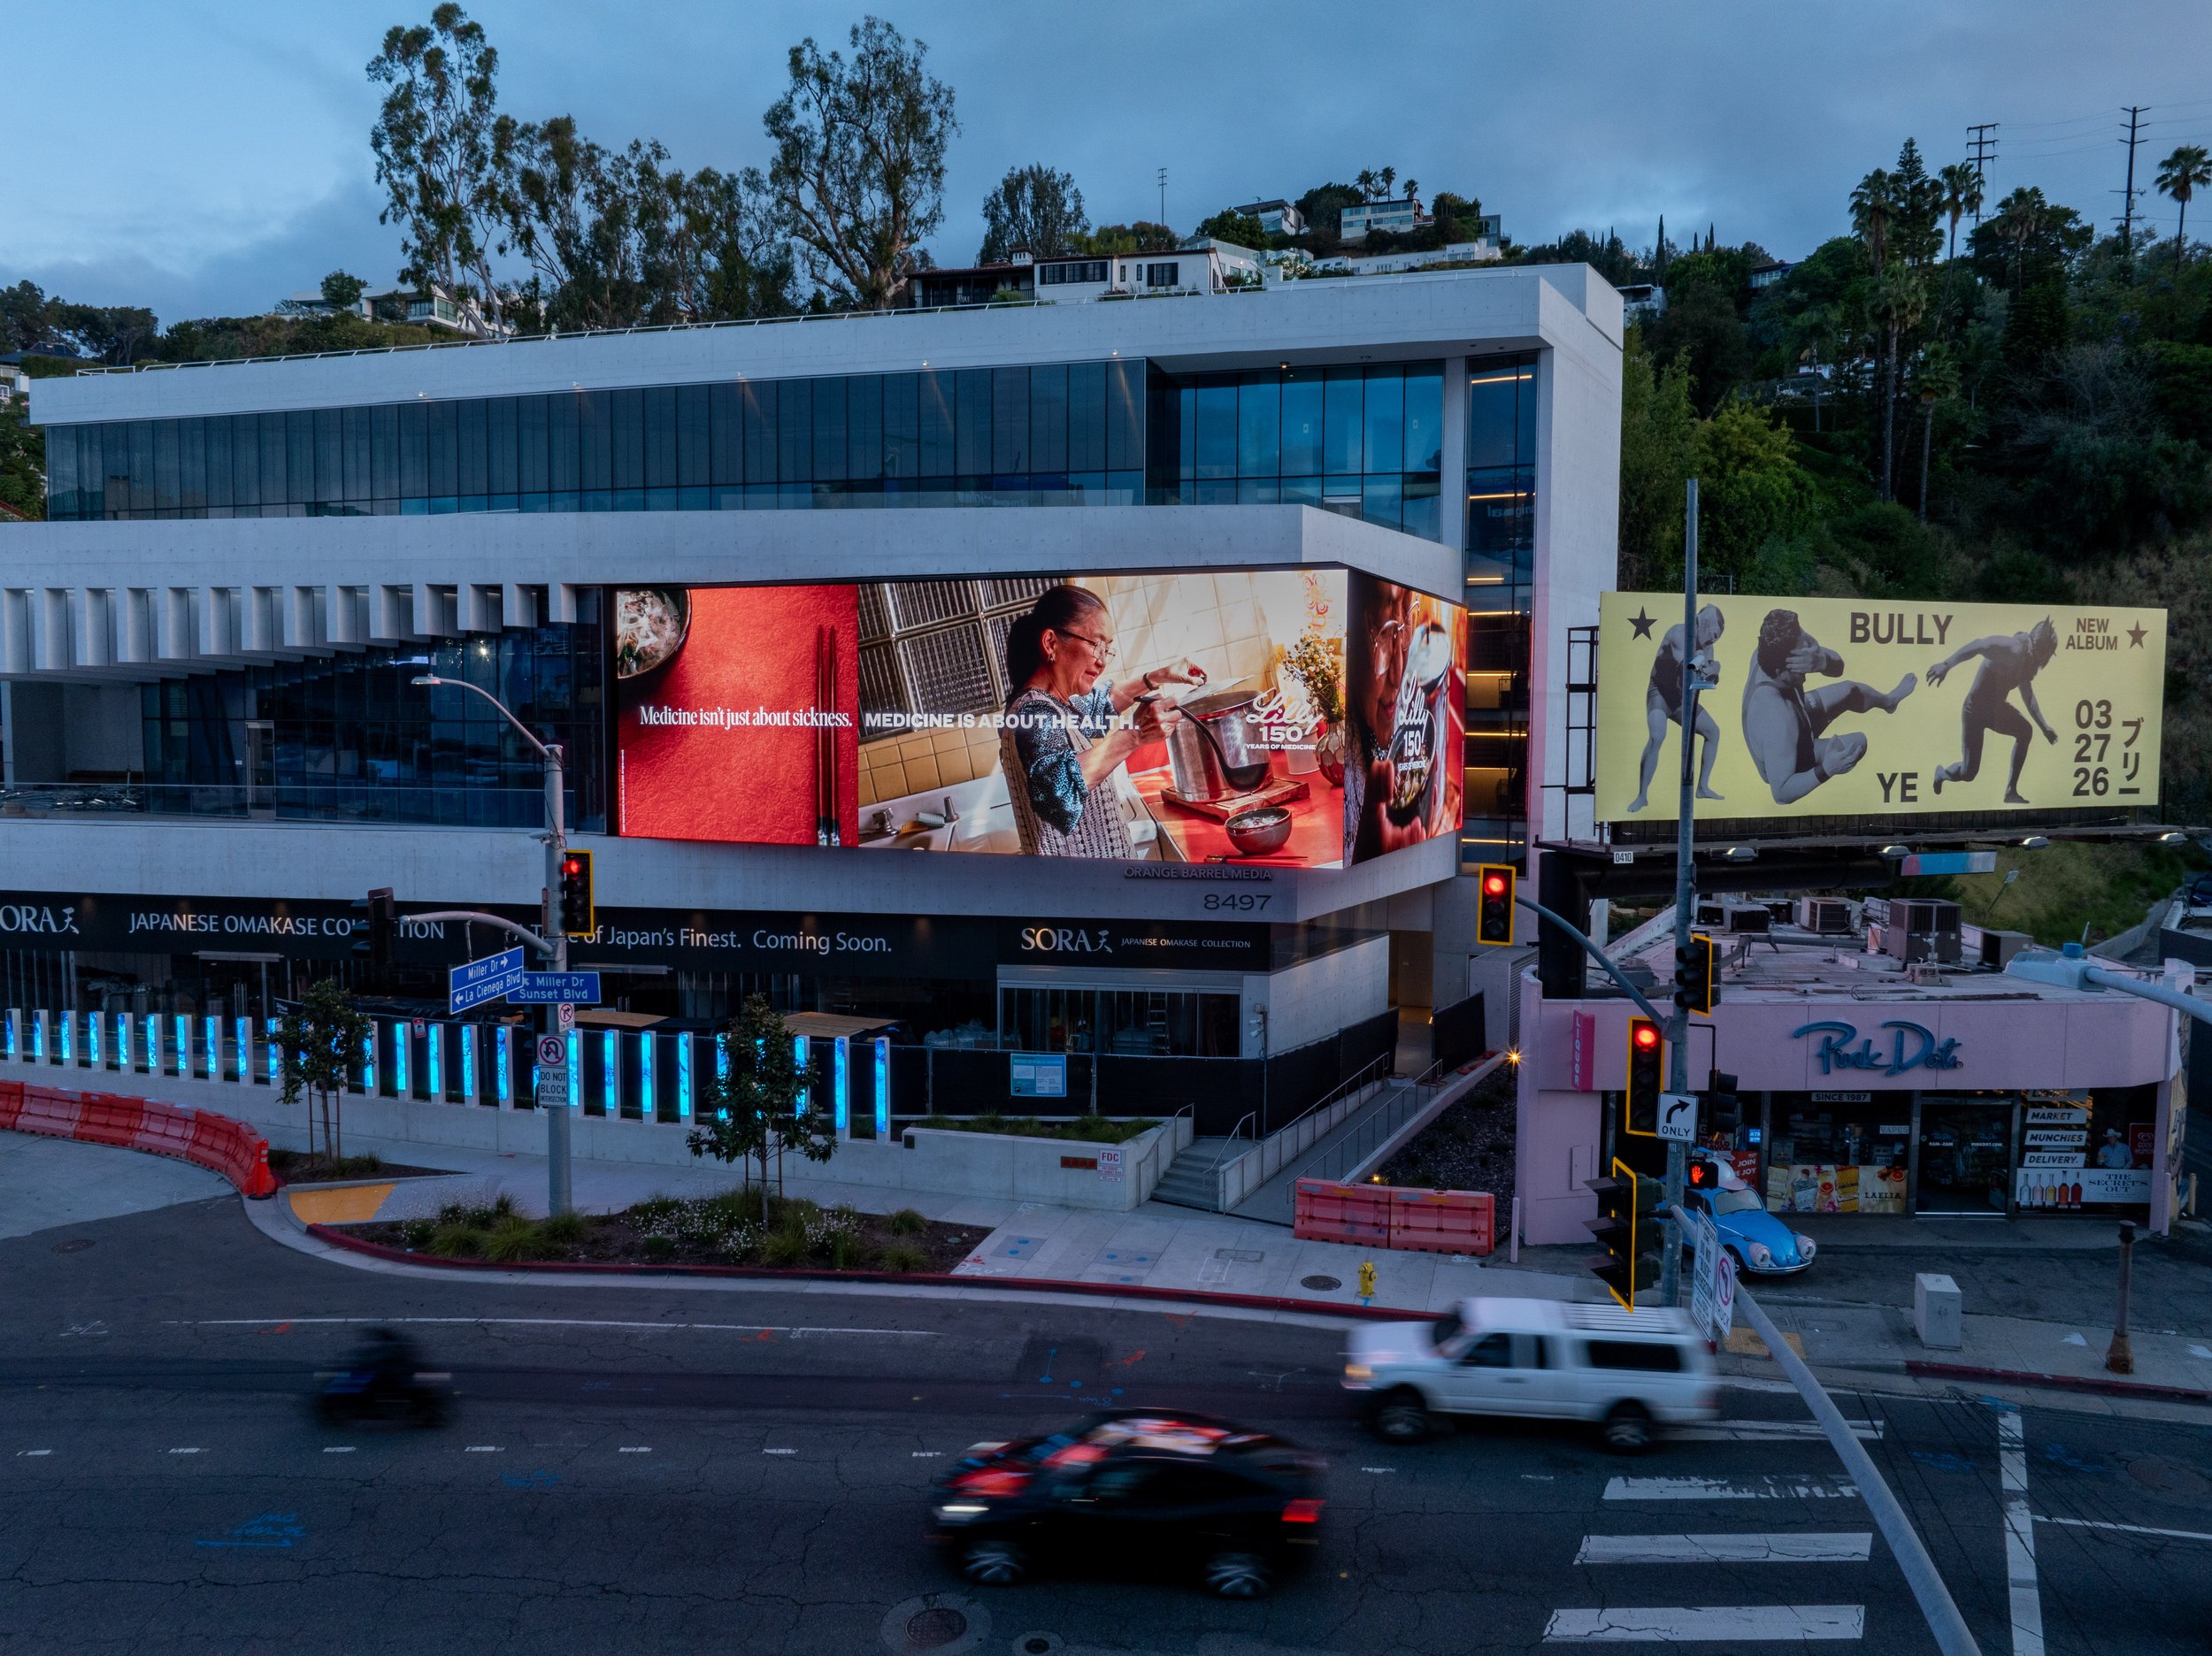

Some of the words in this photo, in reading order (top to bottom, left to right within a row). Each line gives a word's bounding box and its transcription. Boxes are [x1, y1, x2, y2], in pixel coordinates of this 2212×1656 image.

[1850, 612, 1953, 645] BULLY
[2077, 618, 2109, 632] NEW
[2065, 634, 2118, 650] ALBUM
[1246, 687, 1324, 735] Lilly
[1399, 670, 1429, 743] Lilly
[2075, 699, 2112, 729] 03
[640, 706, 697, 724] Medicine
[699, 706, 725, 725] isn't
[725, 708, 750, 730] just
[752, 706, 790, 726] about
[792, 706, 853, 727] sickness.
[865, 713, 954, 728] MEDICINE
[957, 713, 975, 728] IS
[977, 713, 1048, 729] ABOUT
[1052, 715, 1140, 730] HEALTH.
[1259, 726, 1303, 742] 150
[1404, 730, 1422, 756] 150
[2073, 733, 2111, 763] 27
[1877, 772, 1918, 803] YE
[2072, 767, 2109, 796] 26
[1614, 852, 1632, 863] 0410
[1125, 867, 1178, 878] ORANGE
[1181, 868, 1228, 879] BARREL
[1231, 869, 1272, 880] MEDIA
[1203, 893, 1272, 911] 8497
[129, 912, 219, 933] JAPANESE
[224, 916, 318, 936] OMAKASE
[584, 925, 603, 944] of
[607, 926, 674, 949] Japan's
[680, 928, 741, 948] Finest.
[753, 930, 830, 954] Coming
[836, 932, 893, 952] Soon.
[1021, 927, 1092, 952] SORA
[1121, 938, 1157, 947] JAPANESE
[1160, 939, 1198, 947] OMAKASE
[1202, 939, 1251, 948] COLLECTION
[468, 964, 488, 980] Miller
[490, 960, 499, 971] Dr
[465, 990, 474, 1002] La
[476, 980, 503, 999] Cienega
[506, 971, 521, 987] Blvd
[536, 977, 565, 987] Miller
[571, 977, 585, 986] Dr
[518, 988, 558, 1000] Sunset
[563, 988, 588, 1000] Blvd
[1793, 1021, 1893, 1075] Pink
[541, 1072, 550, 1081] DO
[552, 1072, 566, 1082] NOT
[541, 1085, 566, 1094] BLOCK
[2031, 1112, 2072, 1121] MARKET
[1662, 1125, 1691, 1137] ONLY
[1880, 1125, 1909, 1134] VAPES
[2029, 1133, 2084, 1142] MUNCHIES
[1102, 1152, 1118, 1162] FDC
[1737, 1159, 1756, 1168] JOIN
